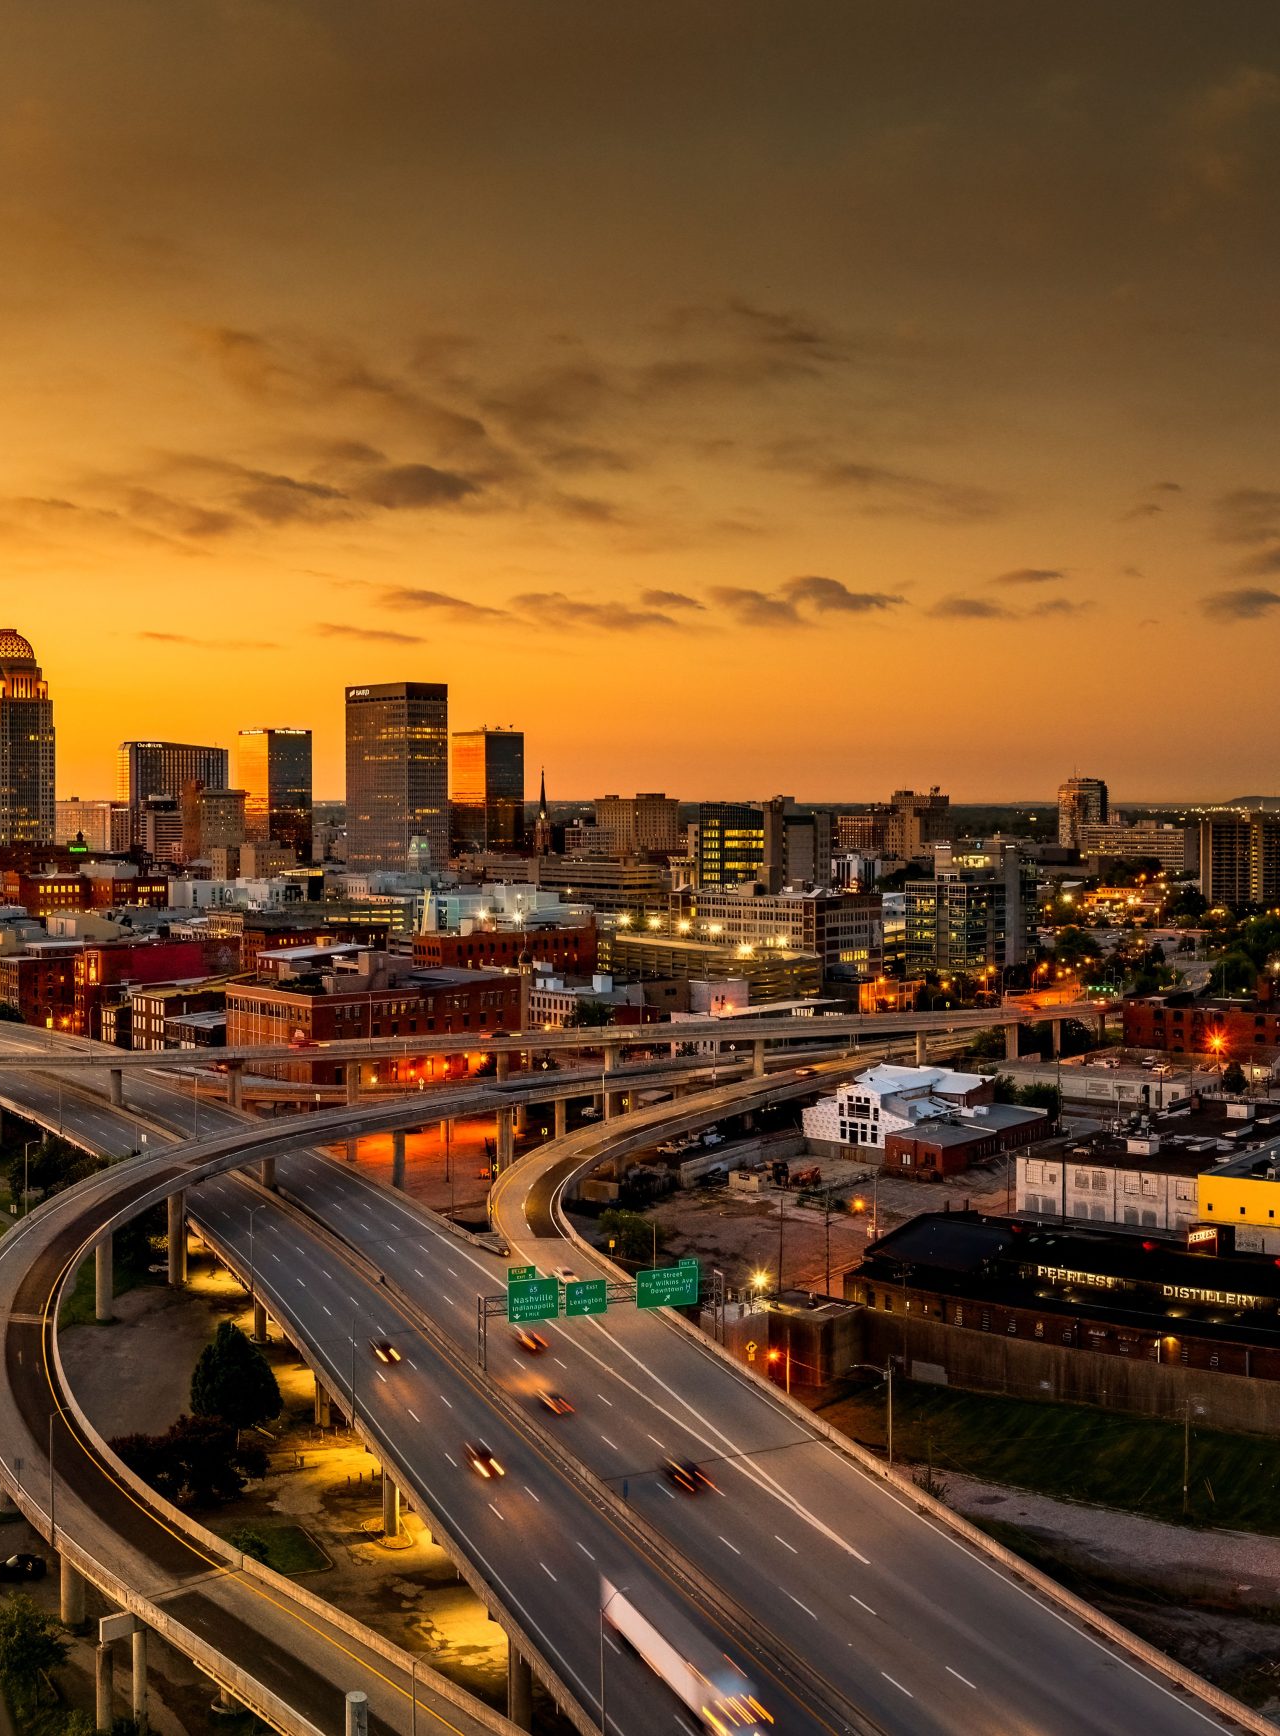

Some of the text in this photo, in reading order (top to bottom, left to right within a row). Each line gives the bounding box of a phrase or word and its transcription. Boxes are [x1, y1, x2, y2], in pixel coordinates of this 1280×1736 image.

[656, 1279, 679, 1287] Wilkins
[1038, 1266, 1259, 1307] PEERLESS DISTILLERY
[514, 1294, 554, 1304] Nashville
[569, 1297, 603, 1306] Lexington
[512, 1303, 555, 1312] Indianapolis
